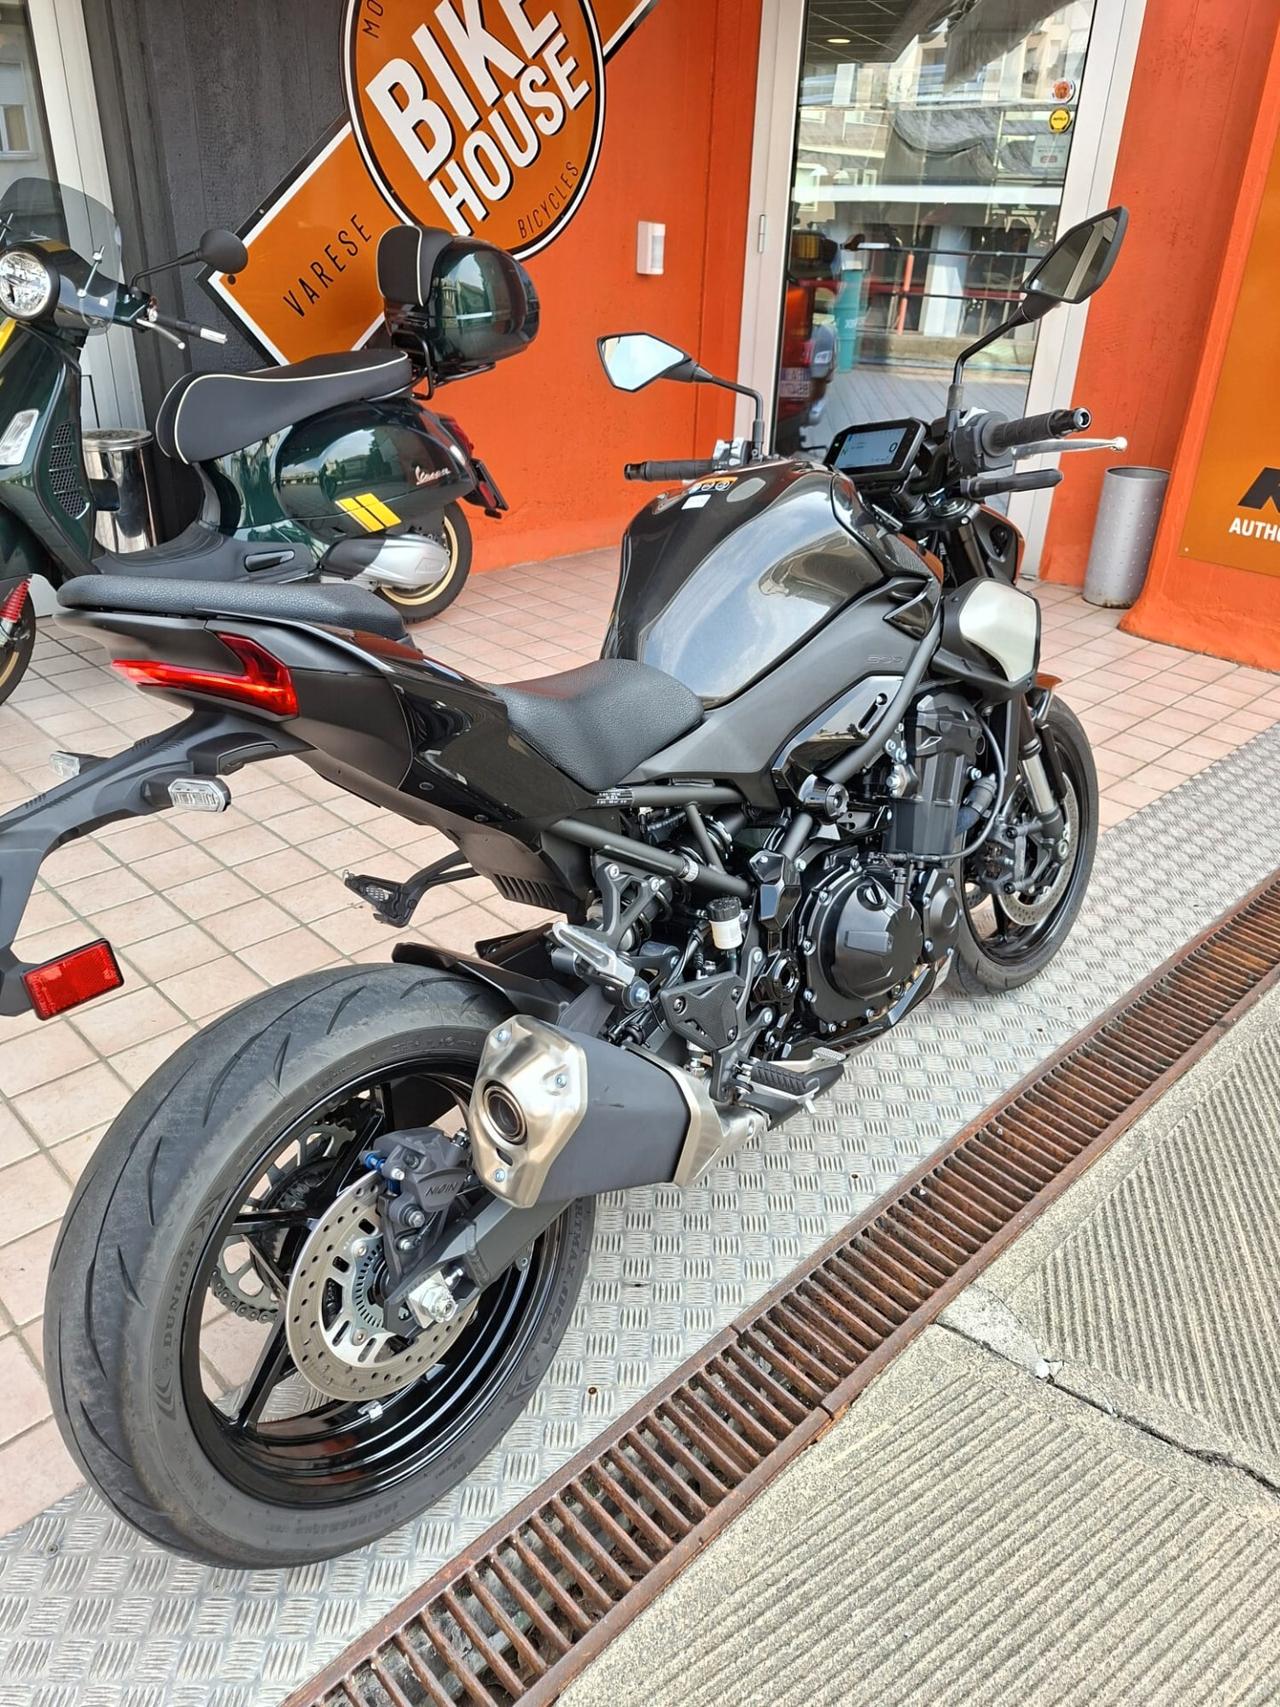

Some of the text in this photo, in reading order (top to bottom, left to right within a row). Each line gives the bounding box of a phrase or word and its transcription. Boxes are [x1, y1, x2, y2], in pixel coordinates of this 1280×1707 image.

[365, 0, 561, 182] BIKE
[428, 32, 592, 237] HOUSE
[517, 160, 580, 239] BICYCLES
[283, 213, 372, 317] VARESE
[415, 465, 451, 486] Vespa
[163, 1240, 196, 1347] DUNLOP
